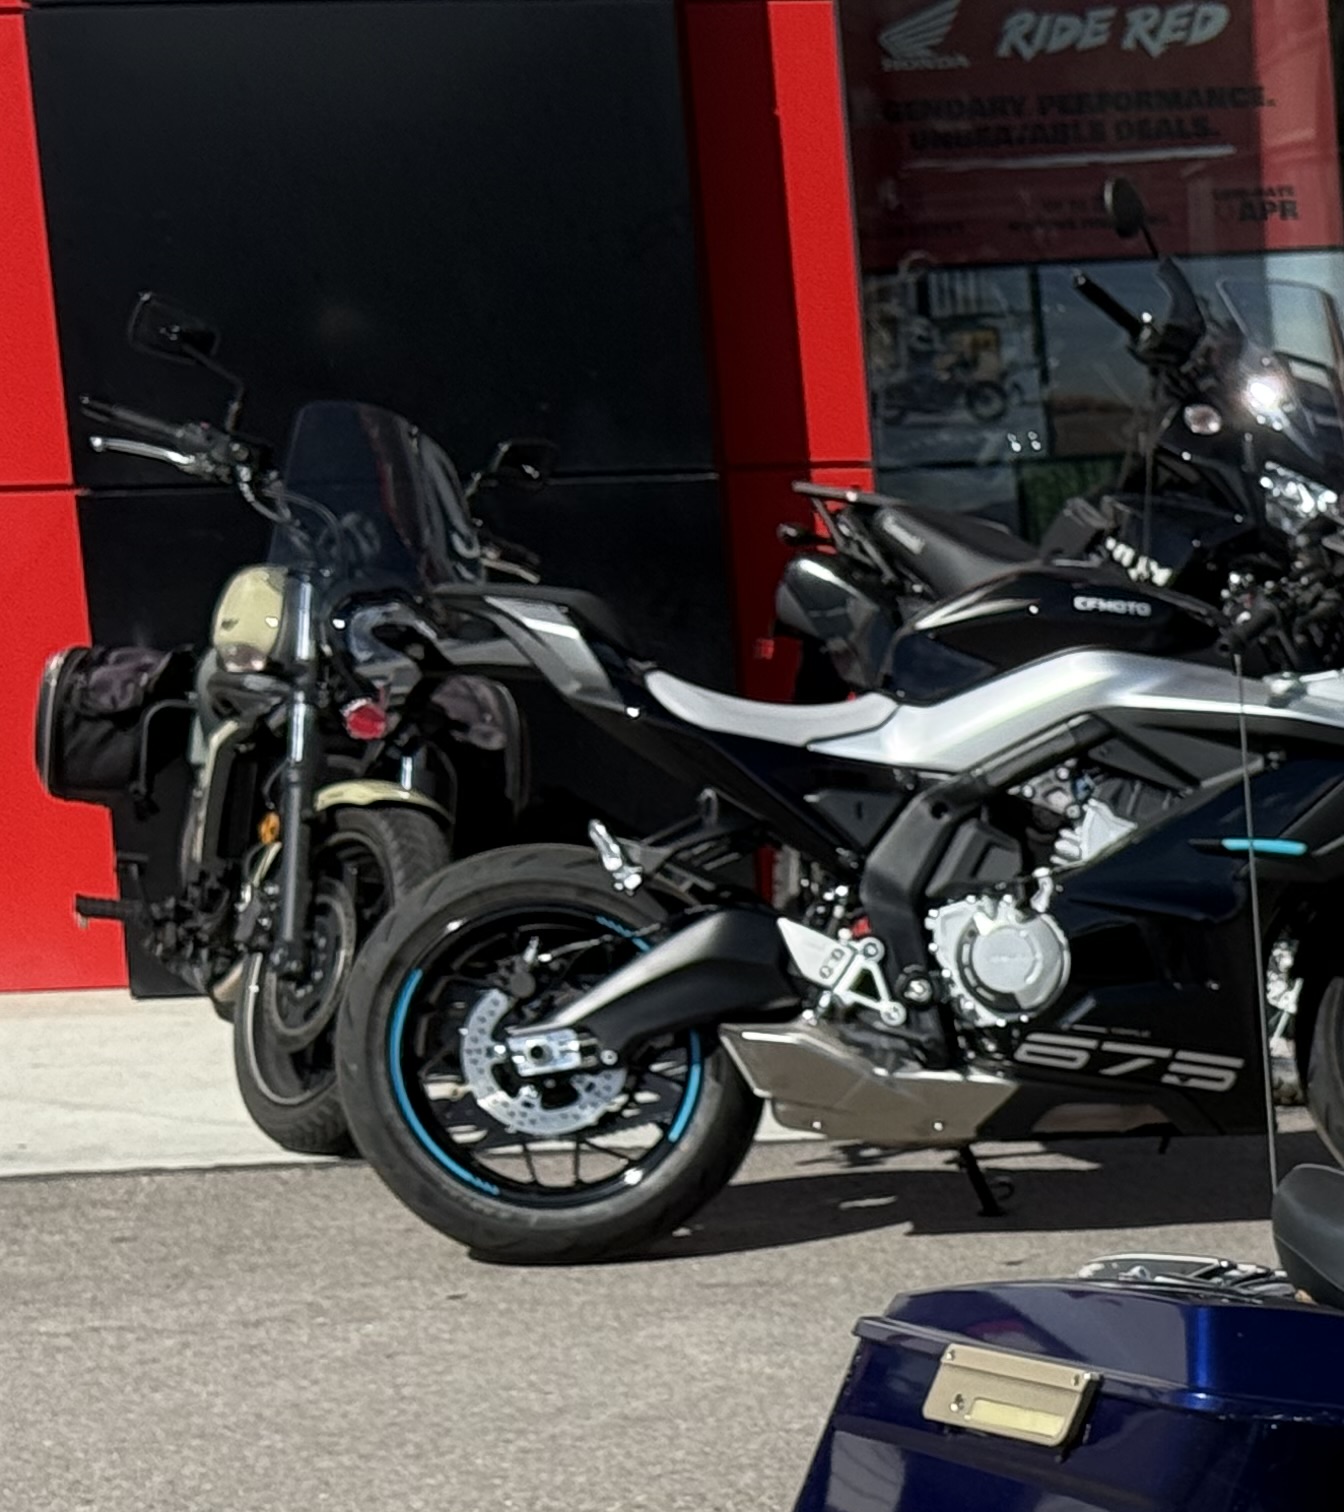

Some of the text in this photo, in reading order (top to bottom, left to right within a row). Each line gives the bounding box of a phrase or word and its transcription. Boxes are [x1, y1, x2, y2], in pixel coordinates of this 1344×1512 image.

[998, 2, 1230, 62] RIDE RED
[1240, 199, 1299, 222] APR
[1013, 1032, 1245, 1092] 675
